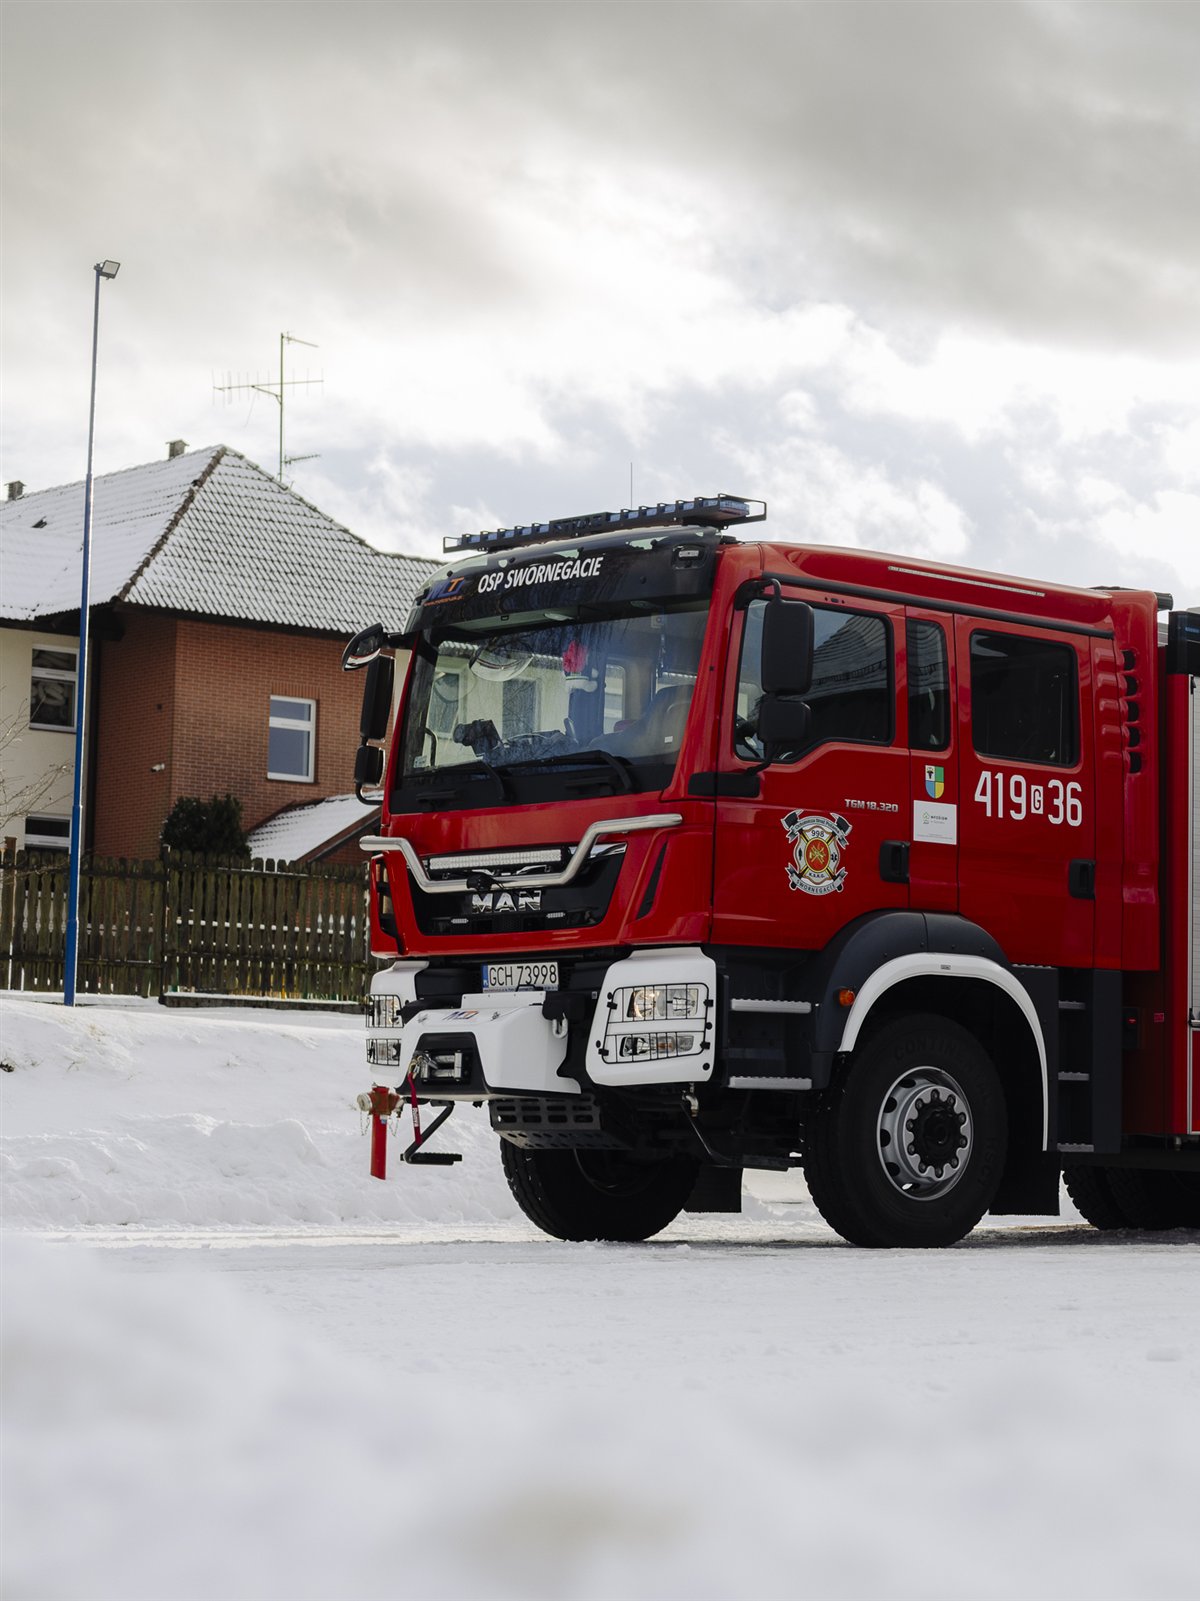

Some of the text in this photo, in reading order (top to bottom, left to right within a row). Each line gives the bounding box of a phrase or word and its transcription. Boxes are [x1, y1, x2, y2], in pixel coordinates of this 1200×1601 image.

[477, 556, 604, 594] OSP SWORNEGACIE
[844, 797, 899, 813] TGM 18.320
[811, 829, 825, 838] 998
[471, 889, 542, 914] MAN
[489, 964, 557, 986] GCH 73998
